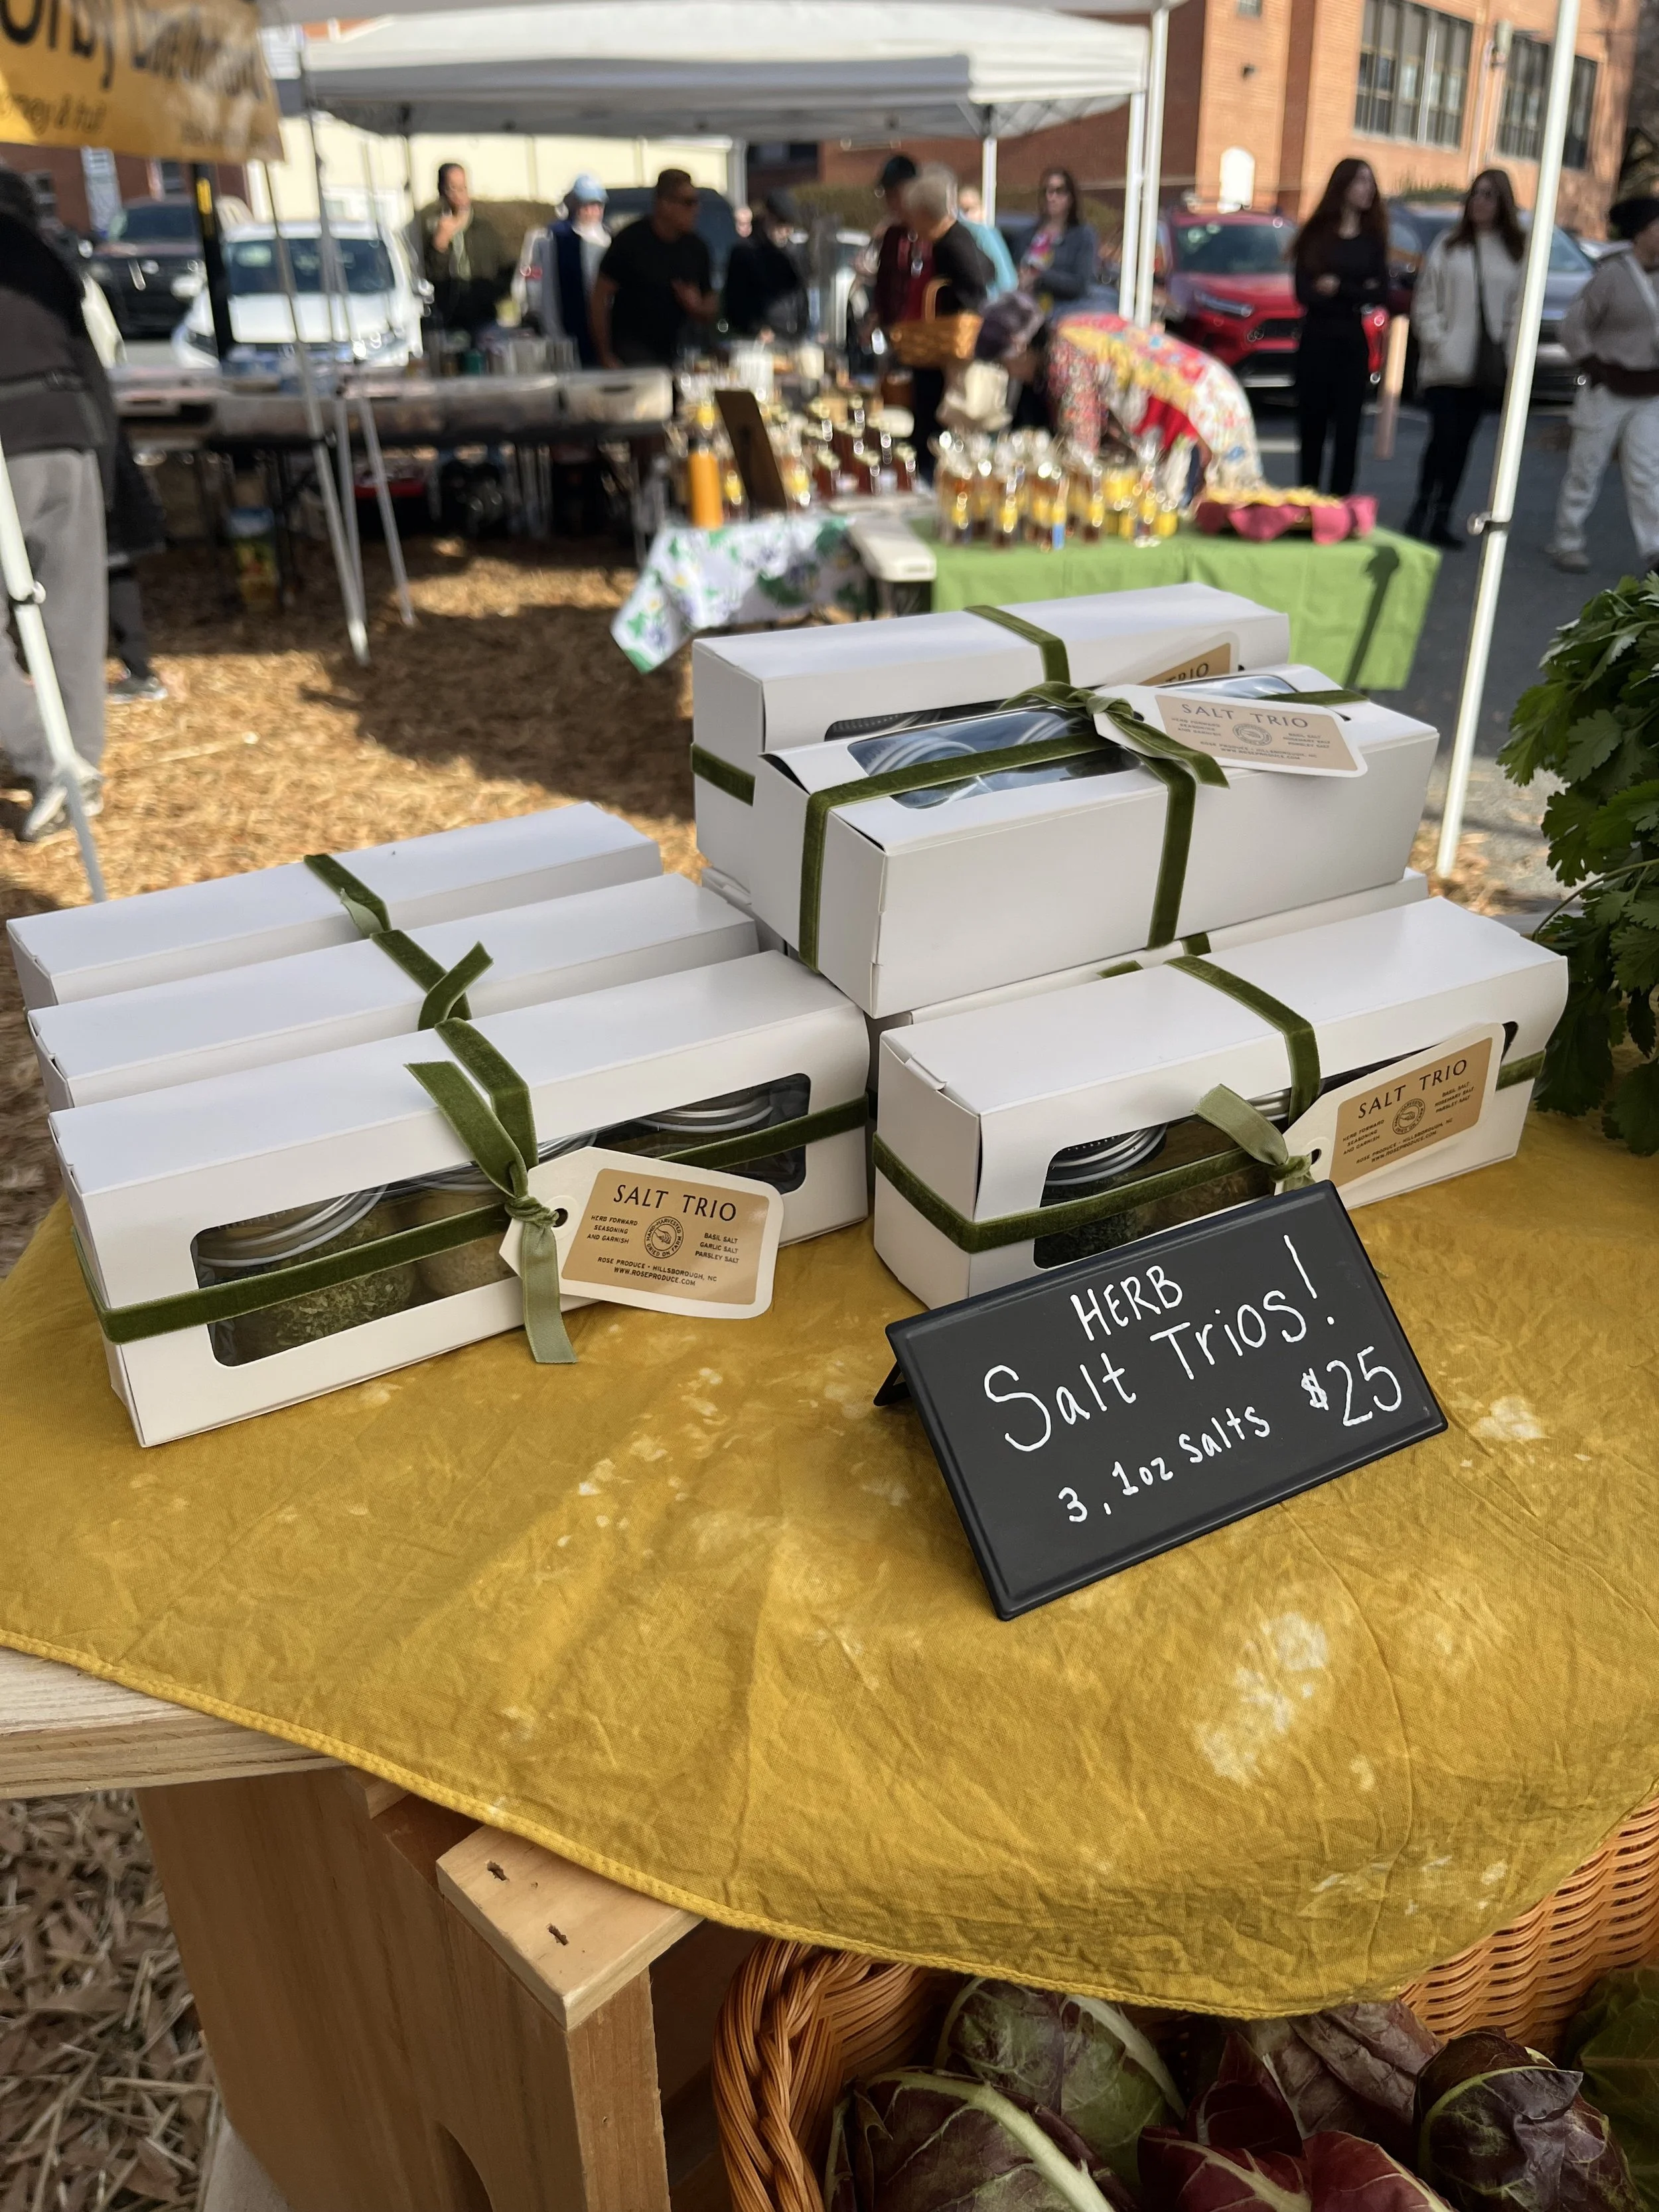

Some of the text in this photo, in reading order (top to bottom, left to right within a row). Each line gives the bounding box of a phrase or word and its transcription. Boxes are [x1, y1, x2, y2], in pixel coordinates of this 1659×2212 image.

[1181, 703, 1308, 728] SALT TRIO
[1358, 1059, 1467, 1119] SALT TRIO
[1342, 1119, 1384, 1142] HERB FORWARD
[1347, 1129, 1378, 1147] SEASONING
[1343, 1135, 1380, 1155] AND GARNISH
[1356, 1154, 1370, 1164] ROSE
[1372, 1142, 1396, 1156] PRODUCE
[613, 1184, 737, 1221] SALT TRIO
[594, 1224, 629, 1234] SEASONING
[609, 1217, 638, 1226] FORWARD
[602, 1234, 630, 1244] GARNISH
[646, 1243, 660, 1256] DRIED
[672, 1236, 682, 1252] FARM
[699, 1242, 722, 1251] GARLIC
[704, 1232, 738, 1244] BASIL SALT
[695, 1250, 723, 1260] PARSLEY
[614, 1266, 695, 1286] WWW.ROSEPRODUCE.COM
[616, 1259, 646, 1269] PRODUCE
[652, 1265, 705, 1280] HILLSBOROUGH,
[1070, 1264, 1183, 1341] HERB
[983, 1234, 1335, 1452] Salt Trios!
[1301, 1345, 1402, 1426] $25
